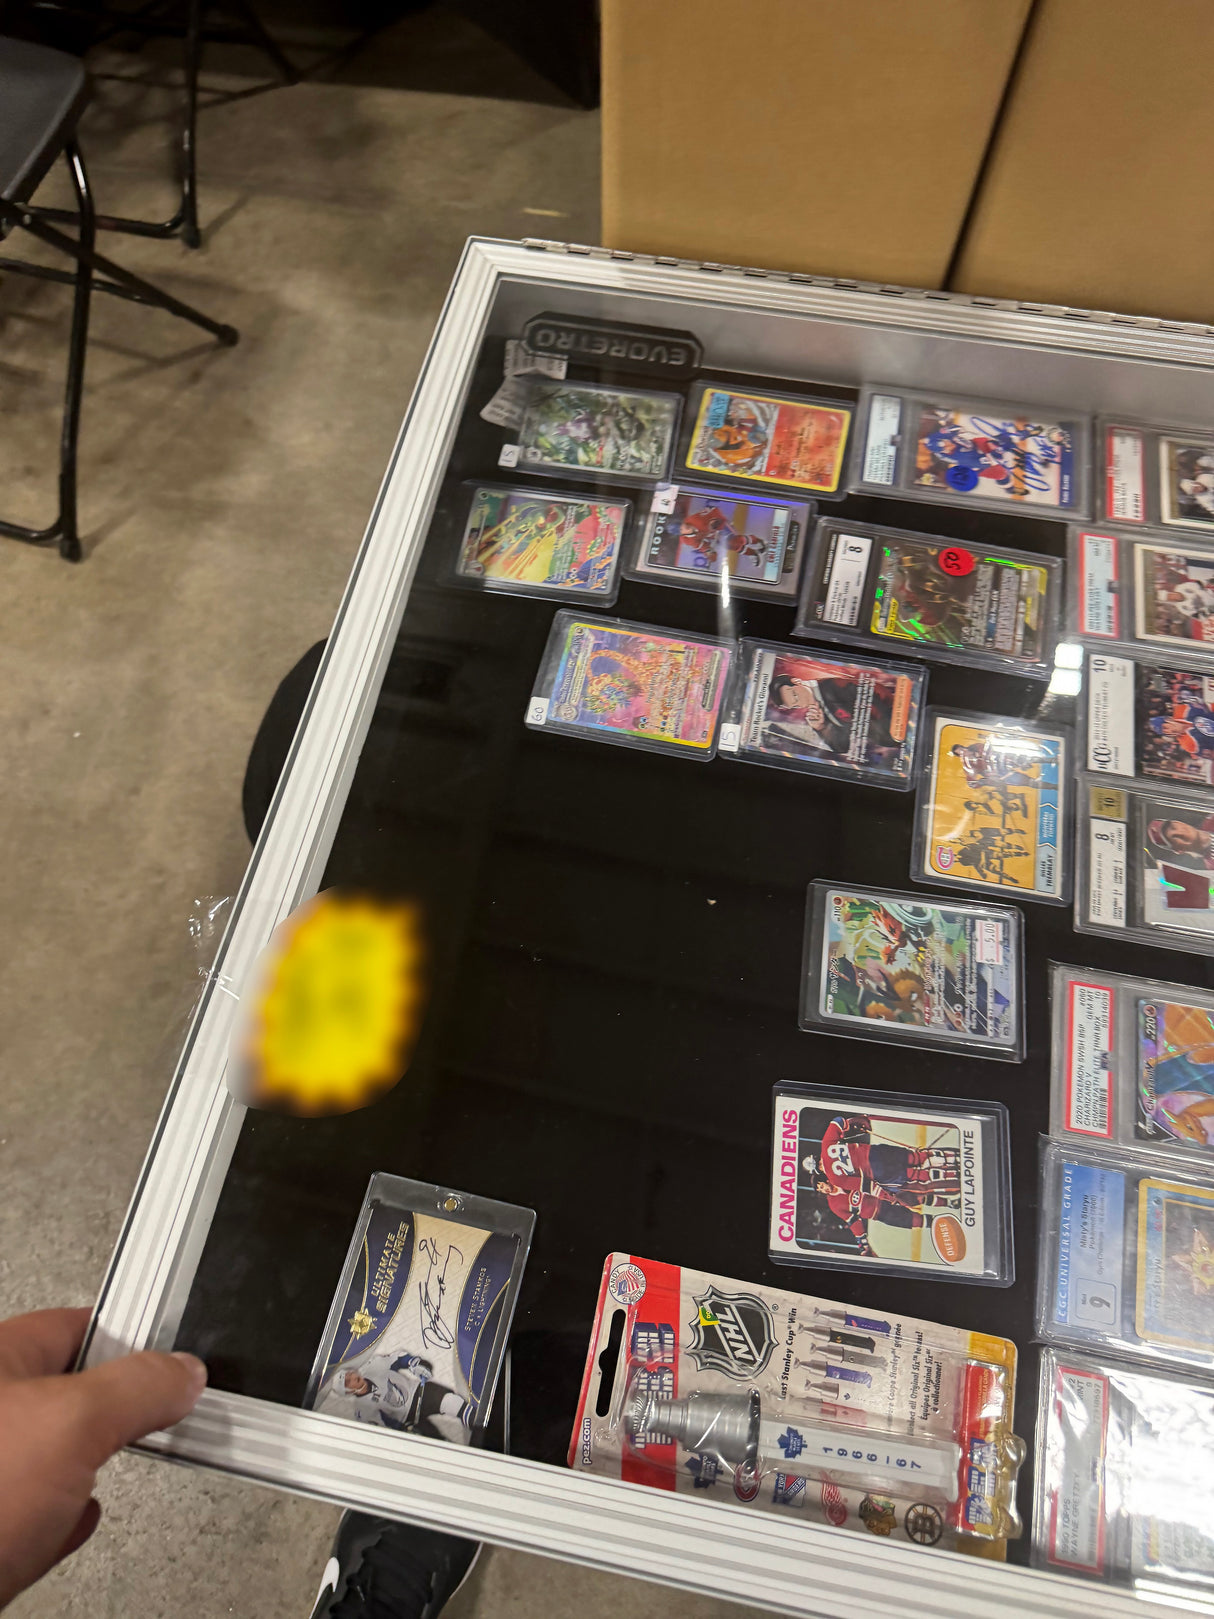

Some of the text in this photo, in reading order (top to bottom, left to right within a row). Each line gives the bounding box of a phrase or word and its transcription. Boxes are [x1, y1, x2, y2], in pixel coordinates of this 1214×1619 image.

[535, 329, 687, 366] EVORETRO
[651, 514, 667, 555] ROOK
[944, 552, 960, 570] 50
[1091, 660, 1107, 672] 10
[531, 707, 544, 722] 60
[750, 674, 769, 743] Team Rocket's Giovanni
[721, 731, 735, 748] 15
[1104, 797, 1115, 808] 10
[1046, 855, 1054, 887] TREMBLAY
[833, 906, 841, 917] 110
[984, 923, 996, 943] 5.00
[1146, 1017, 1156, 1035] 220
[1076, 1065, 1085, 1103] POKEMON
[827, 1142, 855, 1176] 29
[778, 1109, 798, 1242] CANADIENS
[963, 1130, 976, 1227] GUY LAPOINTE
[1064, 1168, 1072, 1209] GRADE
[1080, 1195, 1089, 1248] Misty's Staryu
[939, 1222, 955, 1257] DEFENSE
[1060, 1215, 1070, 1285] UNIVERSAL
[370, 1232, 395, 1297] ULTIMATE
[375, 1221, 410, 1313] SIGNATURES
[610, 1269, 620, 1294] CANDY
[788, 1308, 797, 1324] Win
[1089, 1296, 1111, 1308] 9
[716, 1307, 754, 1361] NHL
[781, 1348, 793, 1380] Stanley
[923, 1366, 934, 1393] Original
[779, 1382, 787, 1400] Last
[909, 1372, 920, 1399] Original
[932, 1360, 943, 1406] collectionner!
[907, 1400, 916, 1410] all
[918, 1395, 930, 1421] Équipes
[582, 1417, 592, 1465] pez.com
[1062, 1499, 1070, 1528] TOPPS
[1071, 1519, 1079, 1557] WAYNE
